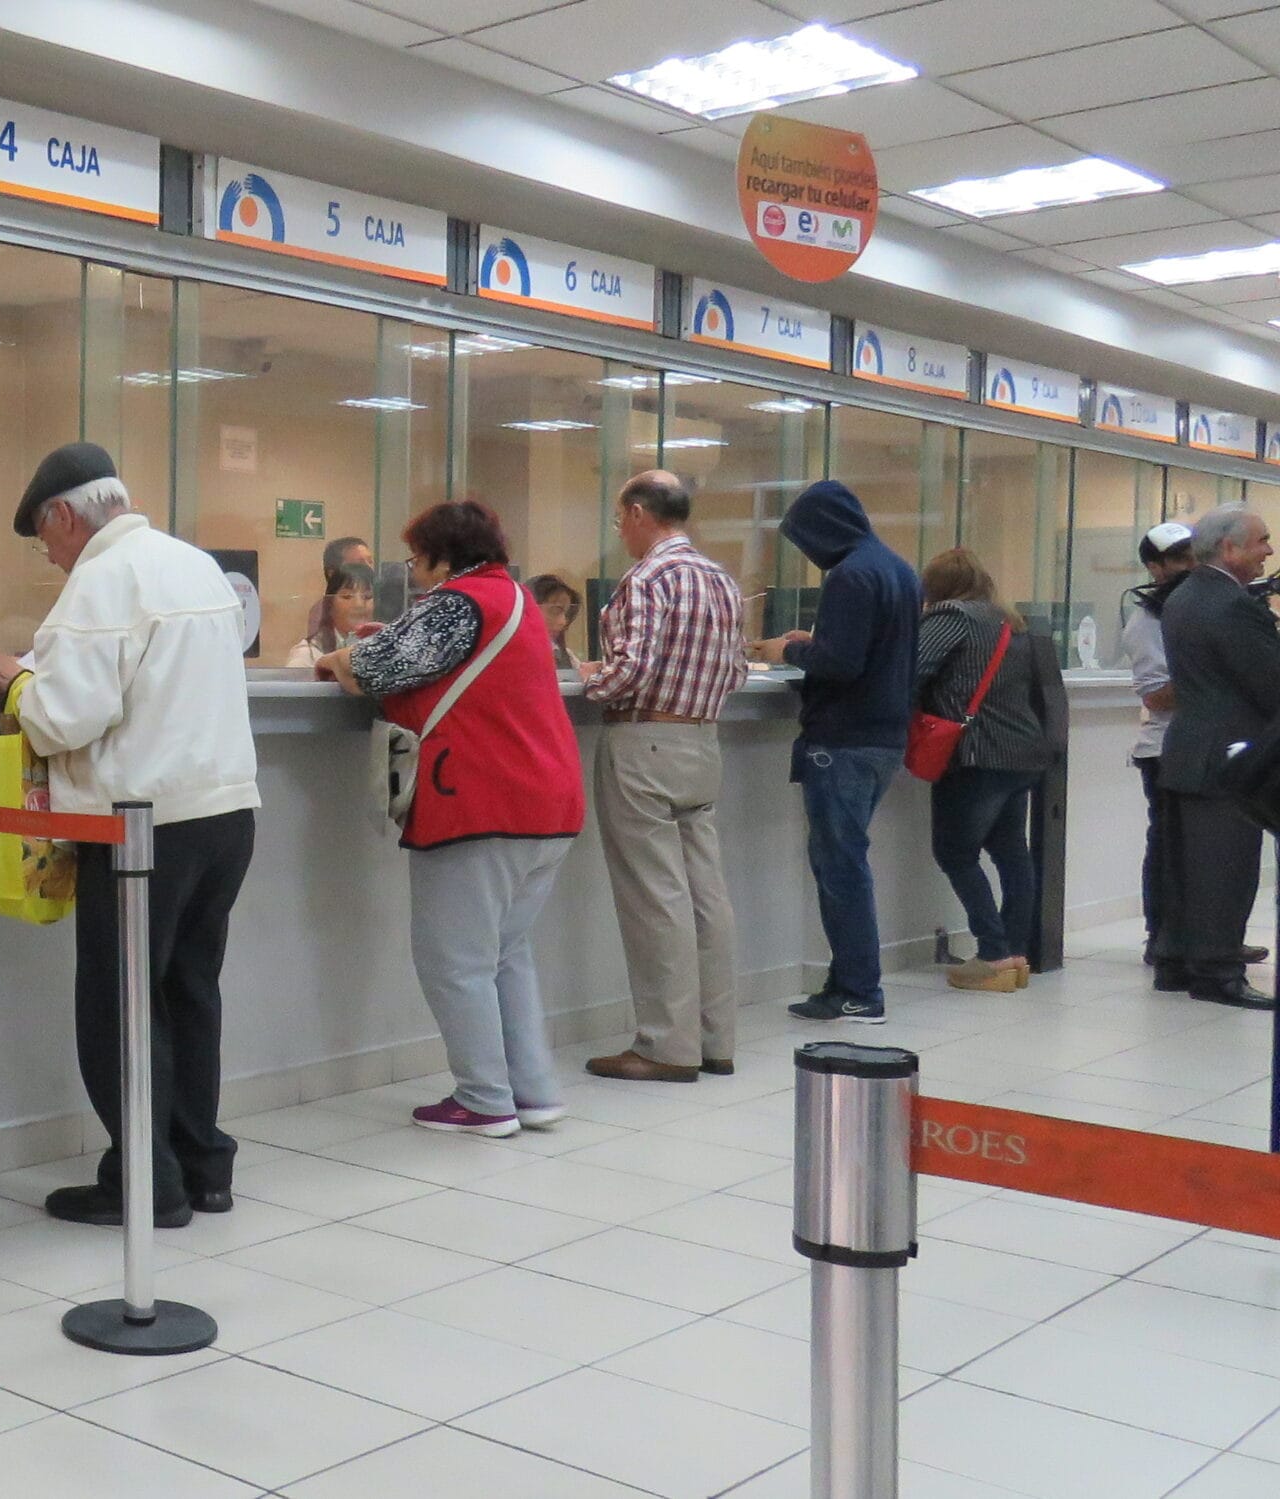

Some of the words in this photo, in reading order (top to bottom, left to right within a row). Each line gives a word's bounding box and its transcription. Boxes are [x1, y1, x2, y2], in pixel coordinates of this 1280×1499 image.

[47, 137, 101, 176] CAJA
[751, 146, 781, 173] Aquí
[781, 155, 832, 180] también
[746, 175, 805, 202] recargar
[807, 184, 822, 203] tu
[825, 188, 873, 212] celular.
[326, 201, 340, 237] 5
[364, 215, 405, 248] CAJA
[565, 260, 577, 291] 6
[591, 269, 621, 298] CAJA
[760, 306, 770, 334] 7
[777, 316, 802, 340] CAJA
[907, 347, 916, 372] 8
[923, 361, 946, 379] CAJA
[1031, 376, 1038, 399] 9
[920, 1119, 1028, 1165] ROES
